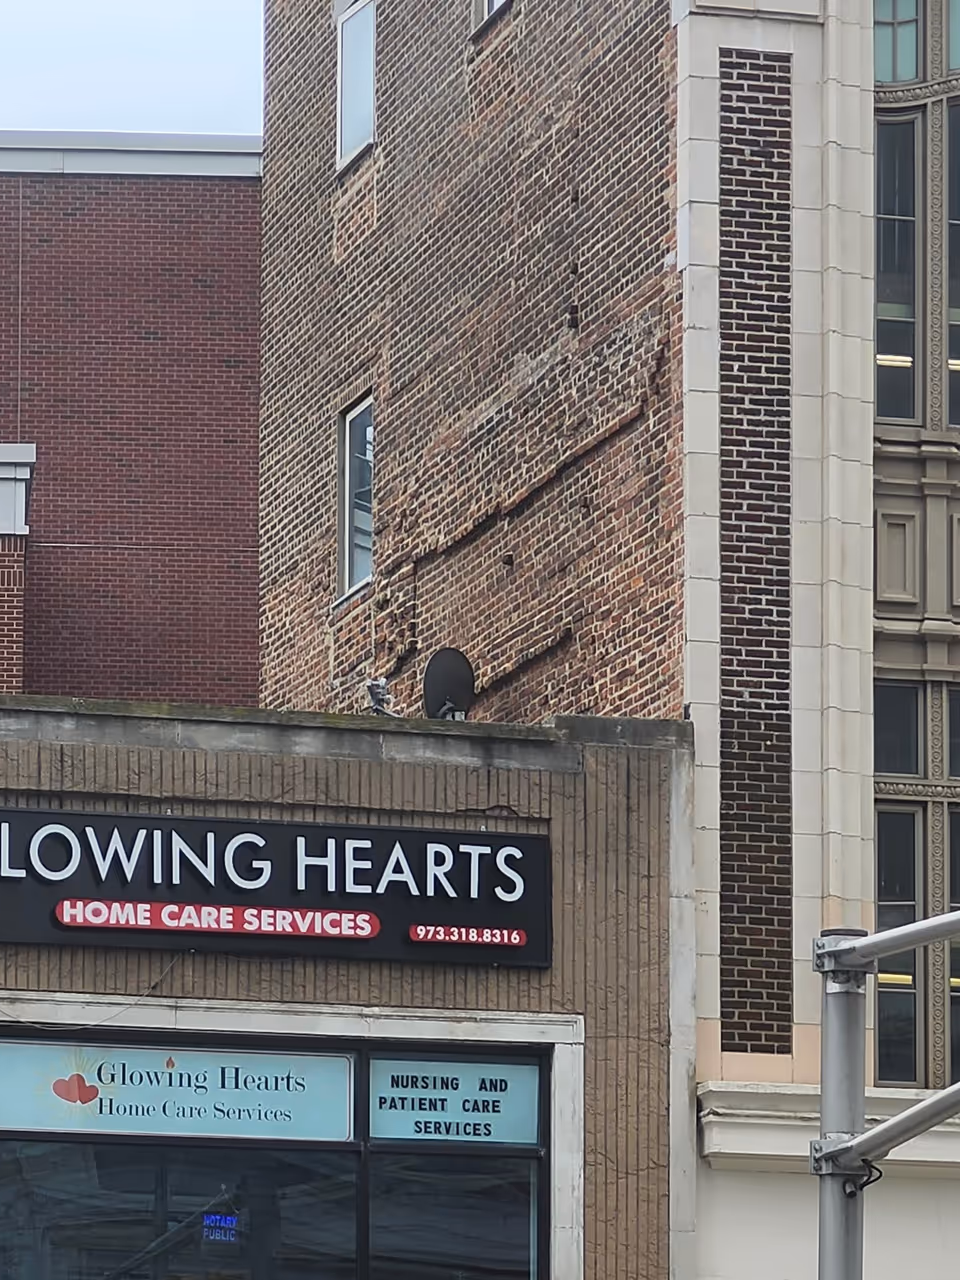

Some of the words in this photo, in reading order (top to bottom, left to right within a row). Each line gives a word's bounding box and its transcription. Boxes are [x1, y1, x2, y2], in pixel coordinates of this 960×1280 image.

[296, 835, 526, 902] HEARTS
[62, 900, 155, 928] HOME
[161, 903, 238, 931] CARE
[242, 907, 372, 937] SERVICES
[415, 925, 521, 945] 973.318.8316
[96, 1061, 208, 1095] Glowing
[219, 1066, 306, 1093] Hearts
[390, 1074, 460, 1090] NURSING
[479, 1078, 508, 1093] AND
[98, 1098, 156, 1118] Home
[162, 1101, 207, 1120] Care
[212, 1101, 292, 1122] Services
[379, 1096, 447, 1112] PATIENT
[462, 1099, 501, 1114] CARE
[414, 1120, 492, 1137] SERVICES
[203, 1215, 237, 1228] NOTARY
[203, 1228, 236, 1241] PUBLIC
